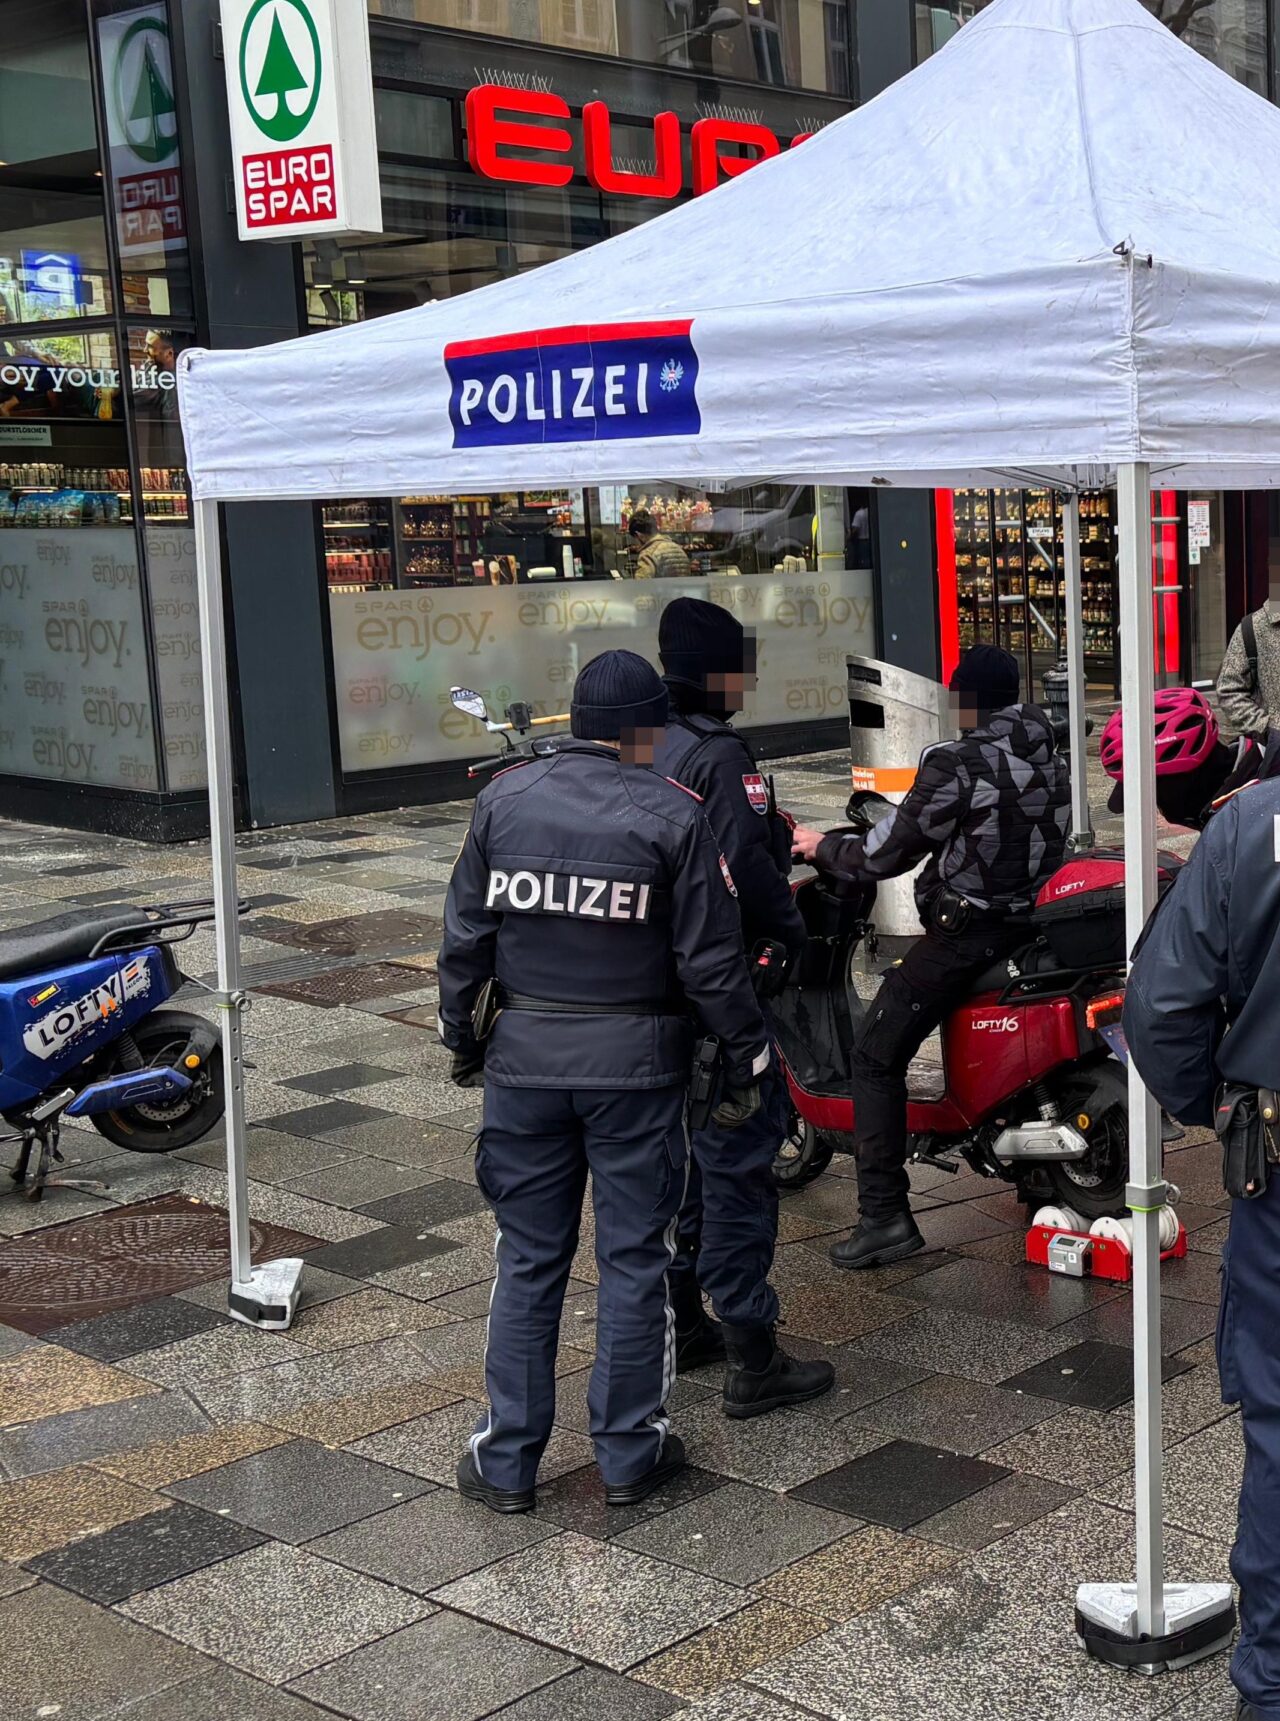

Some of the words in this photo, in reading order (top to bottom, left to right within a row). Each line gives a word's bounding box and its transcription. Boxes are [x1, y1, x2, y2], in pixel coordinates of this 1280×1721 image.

[466, 84, 815, 199] EUR
[246, 152, 330, 189] EURO
[249, 184, 333, 221] SPAR
[47, 368, 120, 392] your
[130, 364, 175, 390] life
[459, 362, 648, 426] POLIZEI
[42, 601, 76, 613] SPAR
[355, 600, 412, 613] SPAR
[518, 590, 556, 600] SPAR
[518, 598, 612, 634] enjoy.
[45, 617, 132, 668] enjoy.
[357, 610, 496, 661] enjoy.
[81, 686, 107, 695] SPAR
[350, 679, 421, 708] enjoy.
[786, 684, 848, 715] enjo
[83, 698, 149, 738] enjoy.
[32, 738, 98, 779] enjoy.
[485, 870, 650, 920] POLIZEI
[1055, 880, 1086, 895] LOFTY
[38, 976, 118, 1047] LOFTY
